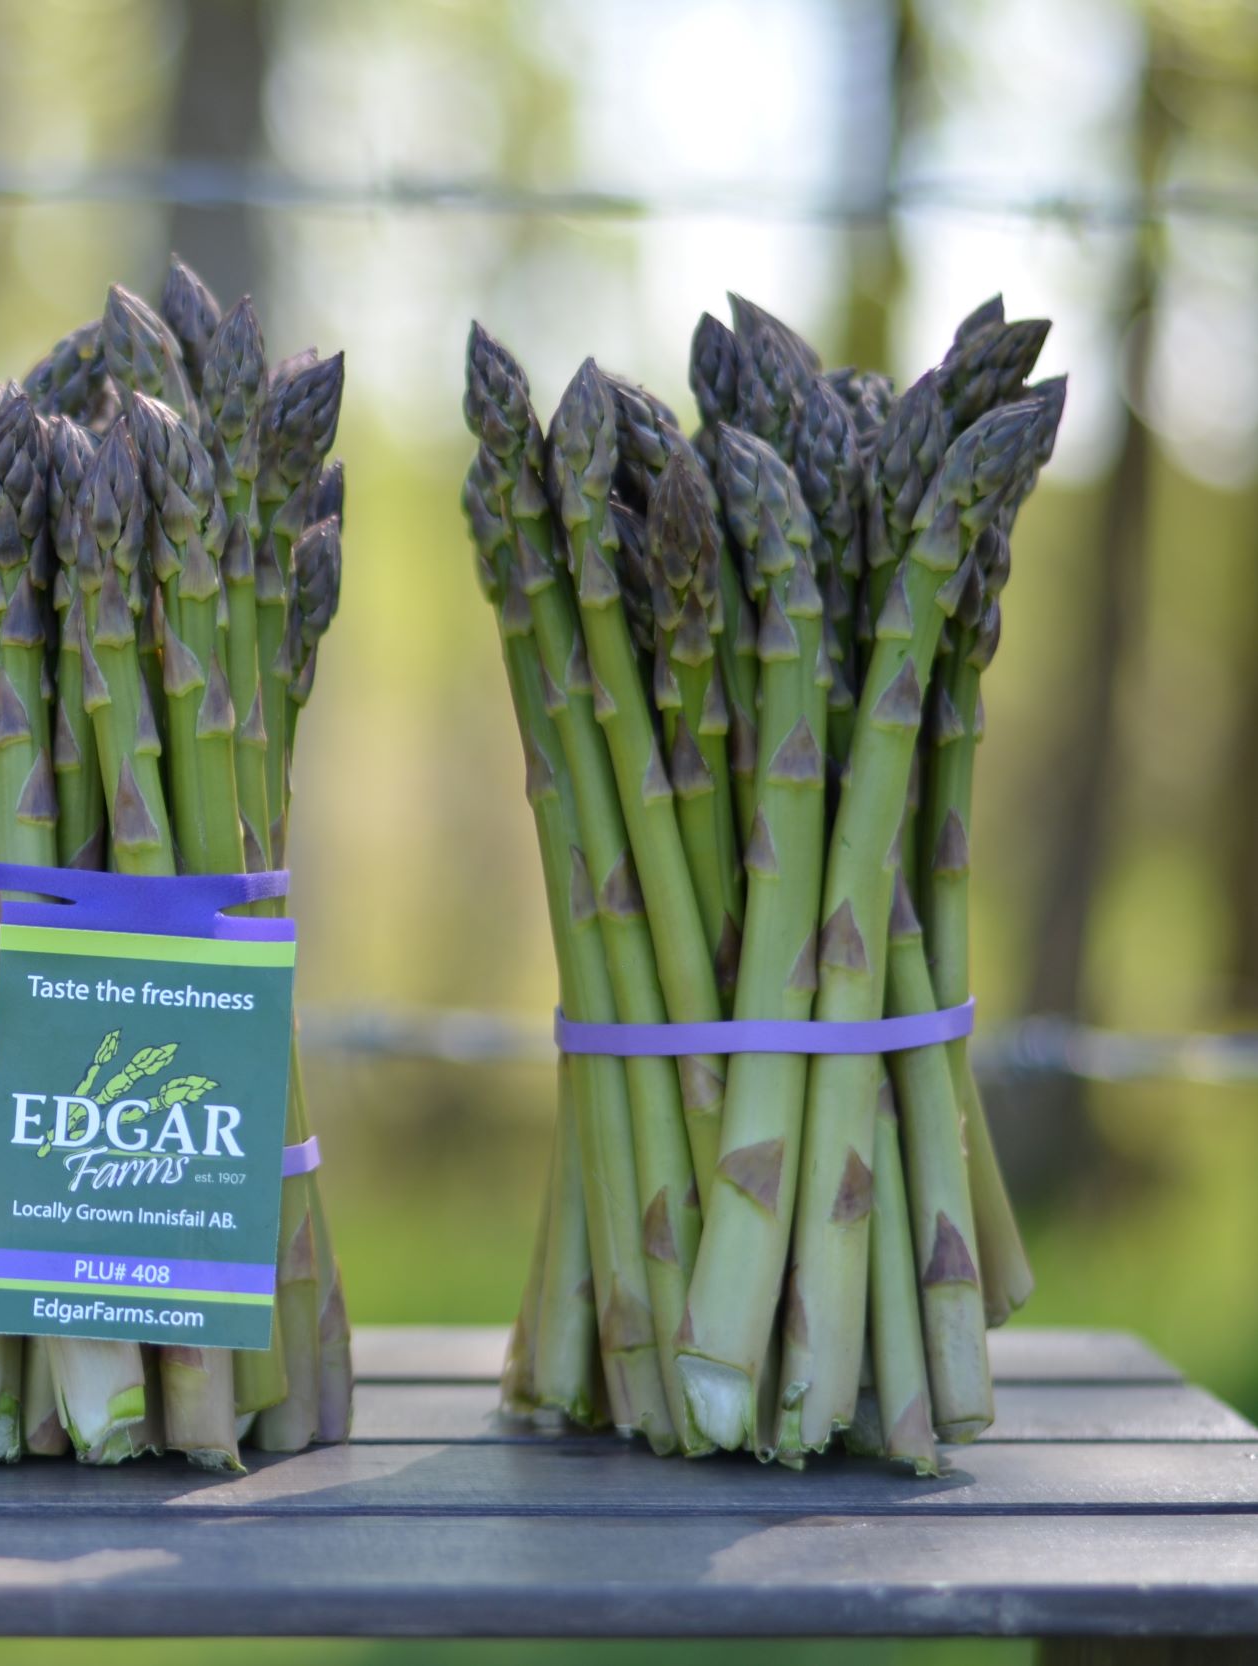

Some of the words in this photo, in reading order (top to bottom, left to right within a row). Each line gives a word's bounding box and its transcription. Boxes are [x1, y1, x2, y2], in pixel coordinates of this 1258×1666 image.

[28, 975, 88, 1001] Taste
[96, 979, 136, 1004] the
[141, 982, 254, 1010] freshness
[10, 1093, 244, 1157] EDGAR
[64, 1146, 189, 1192] Farms
[194, 1173, 214, 1184] est.
[218, 1172, 246, 1185] 1907
[12, 1200, 71, 1223] Locally
[76, 1204, 133, 1223] Grown
[138, 1207, 204, 1227] Innisfail
[208, 1212, 236, 1229] AB.
[74, 1260, 125, 1281] PLU#
[131, 1264, 170, 1284] 408
[33, 1298, 204, 1328] EdgarFarms.com
